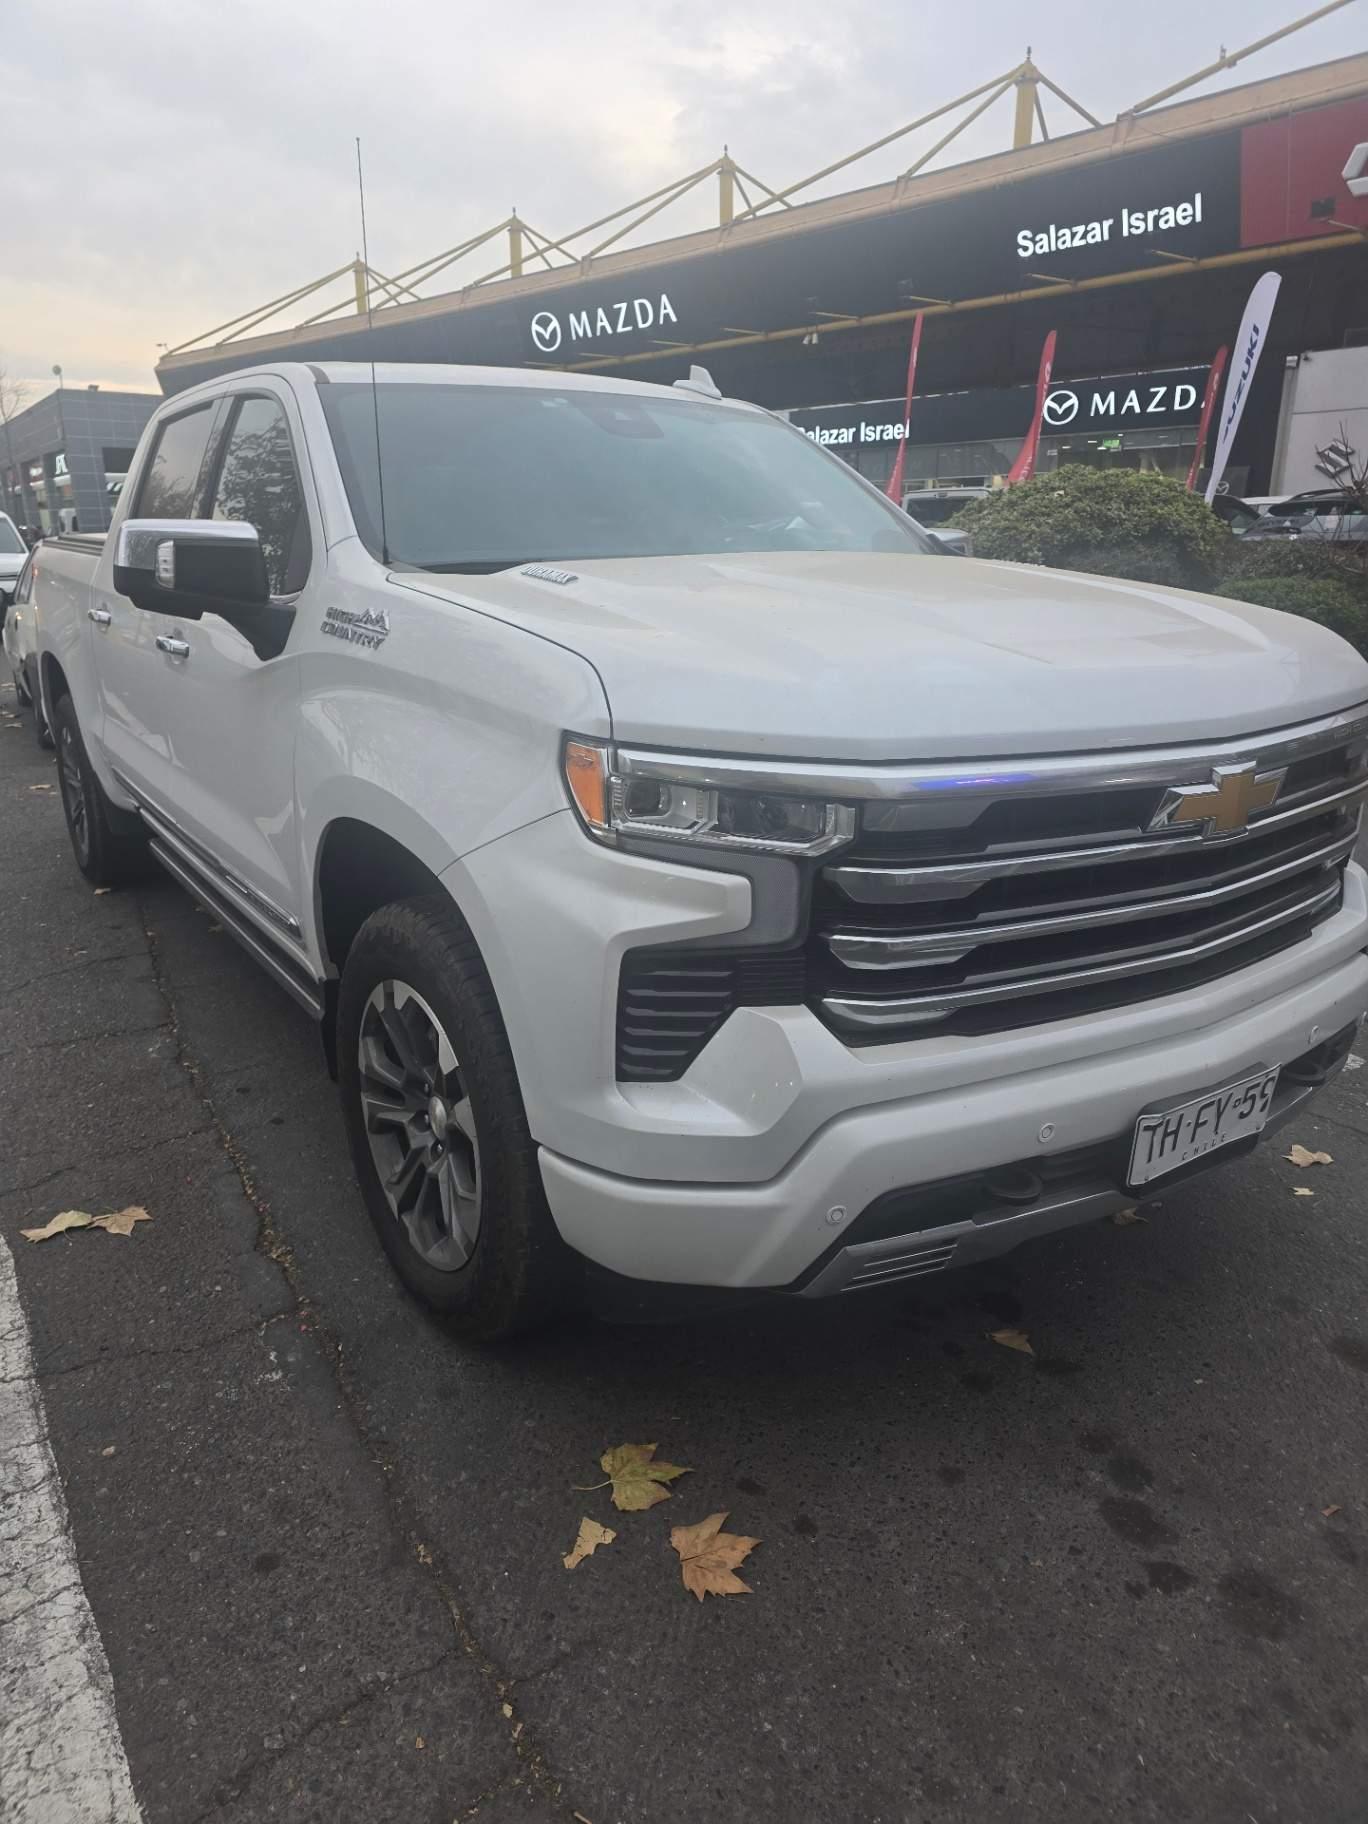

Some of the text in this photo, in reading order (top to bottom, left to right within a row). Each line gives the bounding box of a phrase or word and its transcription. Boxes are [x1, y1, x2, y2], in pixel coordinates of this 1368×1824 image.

[1016, 192, 1203, 258] Salazar Israel
[569, 293, 678, 341] MAZDA
[1090, 384, 1206, 417] MAZD
[860, 418, 910, 442] Israel
